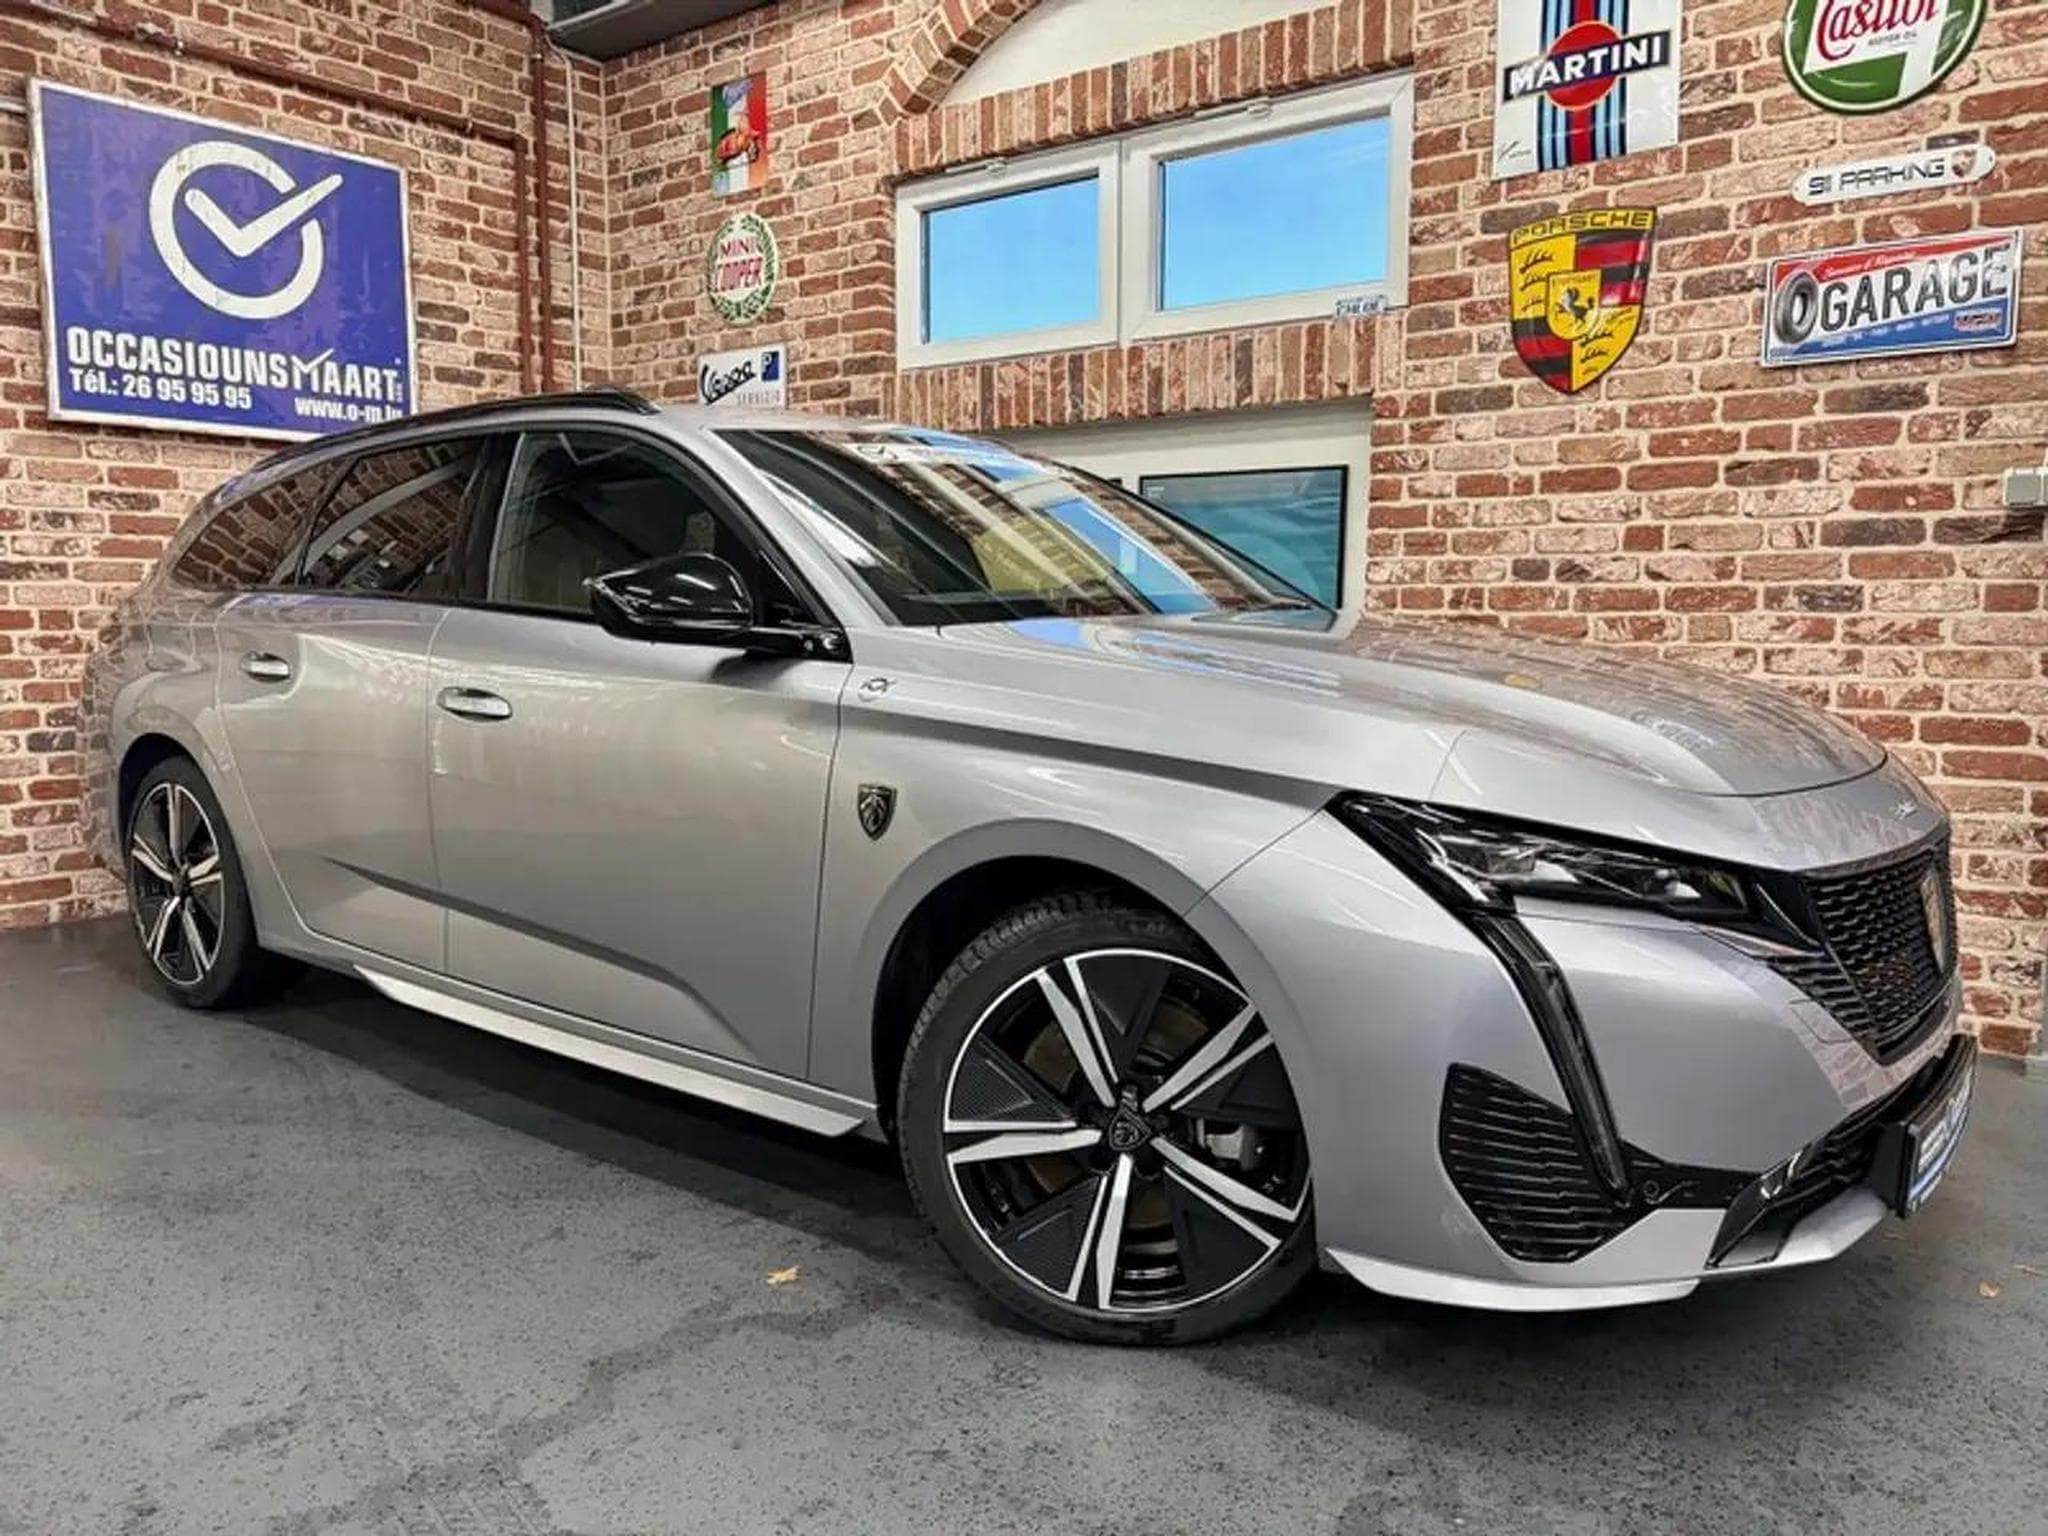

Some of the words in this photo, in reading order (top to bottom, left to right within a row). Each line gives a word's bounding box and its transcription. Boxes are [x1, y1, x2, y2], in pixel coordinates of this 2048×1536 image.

[1509, 36, 1661, 96] MARTINI
[1839, 158, 1945, 191] PARKING
[1513, 211, 1650, 245] PORSCHE
[1820, 243, 2011, 332] GARAGE
[123, 375, 152, 398] 26
[156, 379, 185, 403] 95
[190, 382, 219, 406] 95
[225, 387, 252, 410] 95
